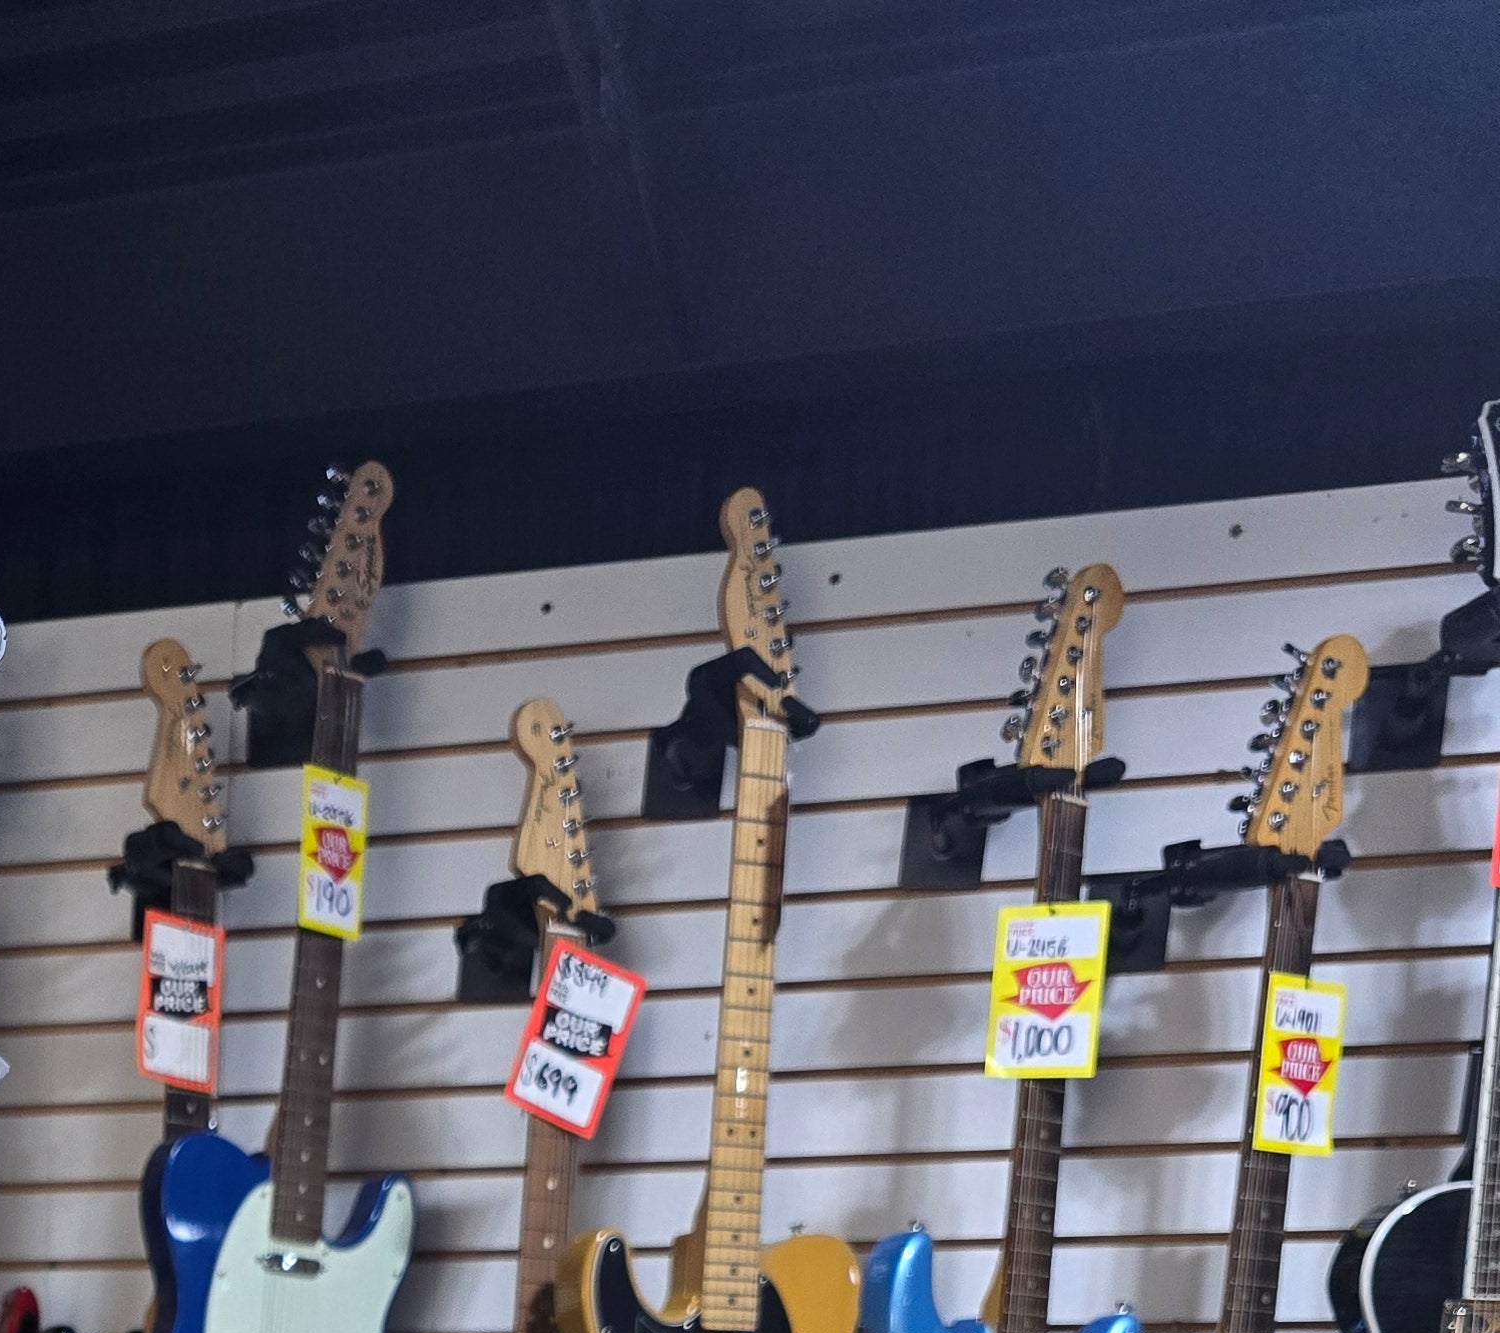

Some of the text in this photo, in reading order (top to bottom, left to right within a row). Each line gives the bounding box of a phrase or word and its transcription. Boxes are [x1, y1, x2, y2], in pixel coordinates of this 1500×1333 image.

[160, 977, 199, 997] OUR
[1027, 966, 1072, 987] OUR
[153, 993, 208, 1014] PRICE
[1019, 985, 1077, 1006] PRICE
[555, 1009, 602, 1037] OUR
[543, 1021, 609, 1056] PRICE
[1286, 1040, 1320, 1063] OUR
[1280, 1059, 1322, 1083] PRICE
